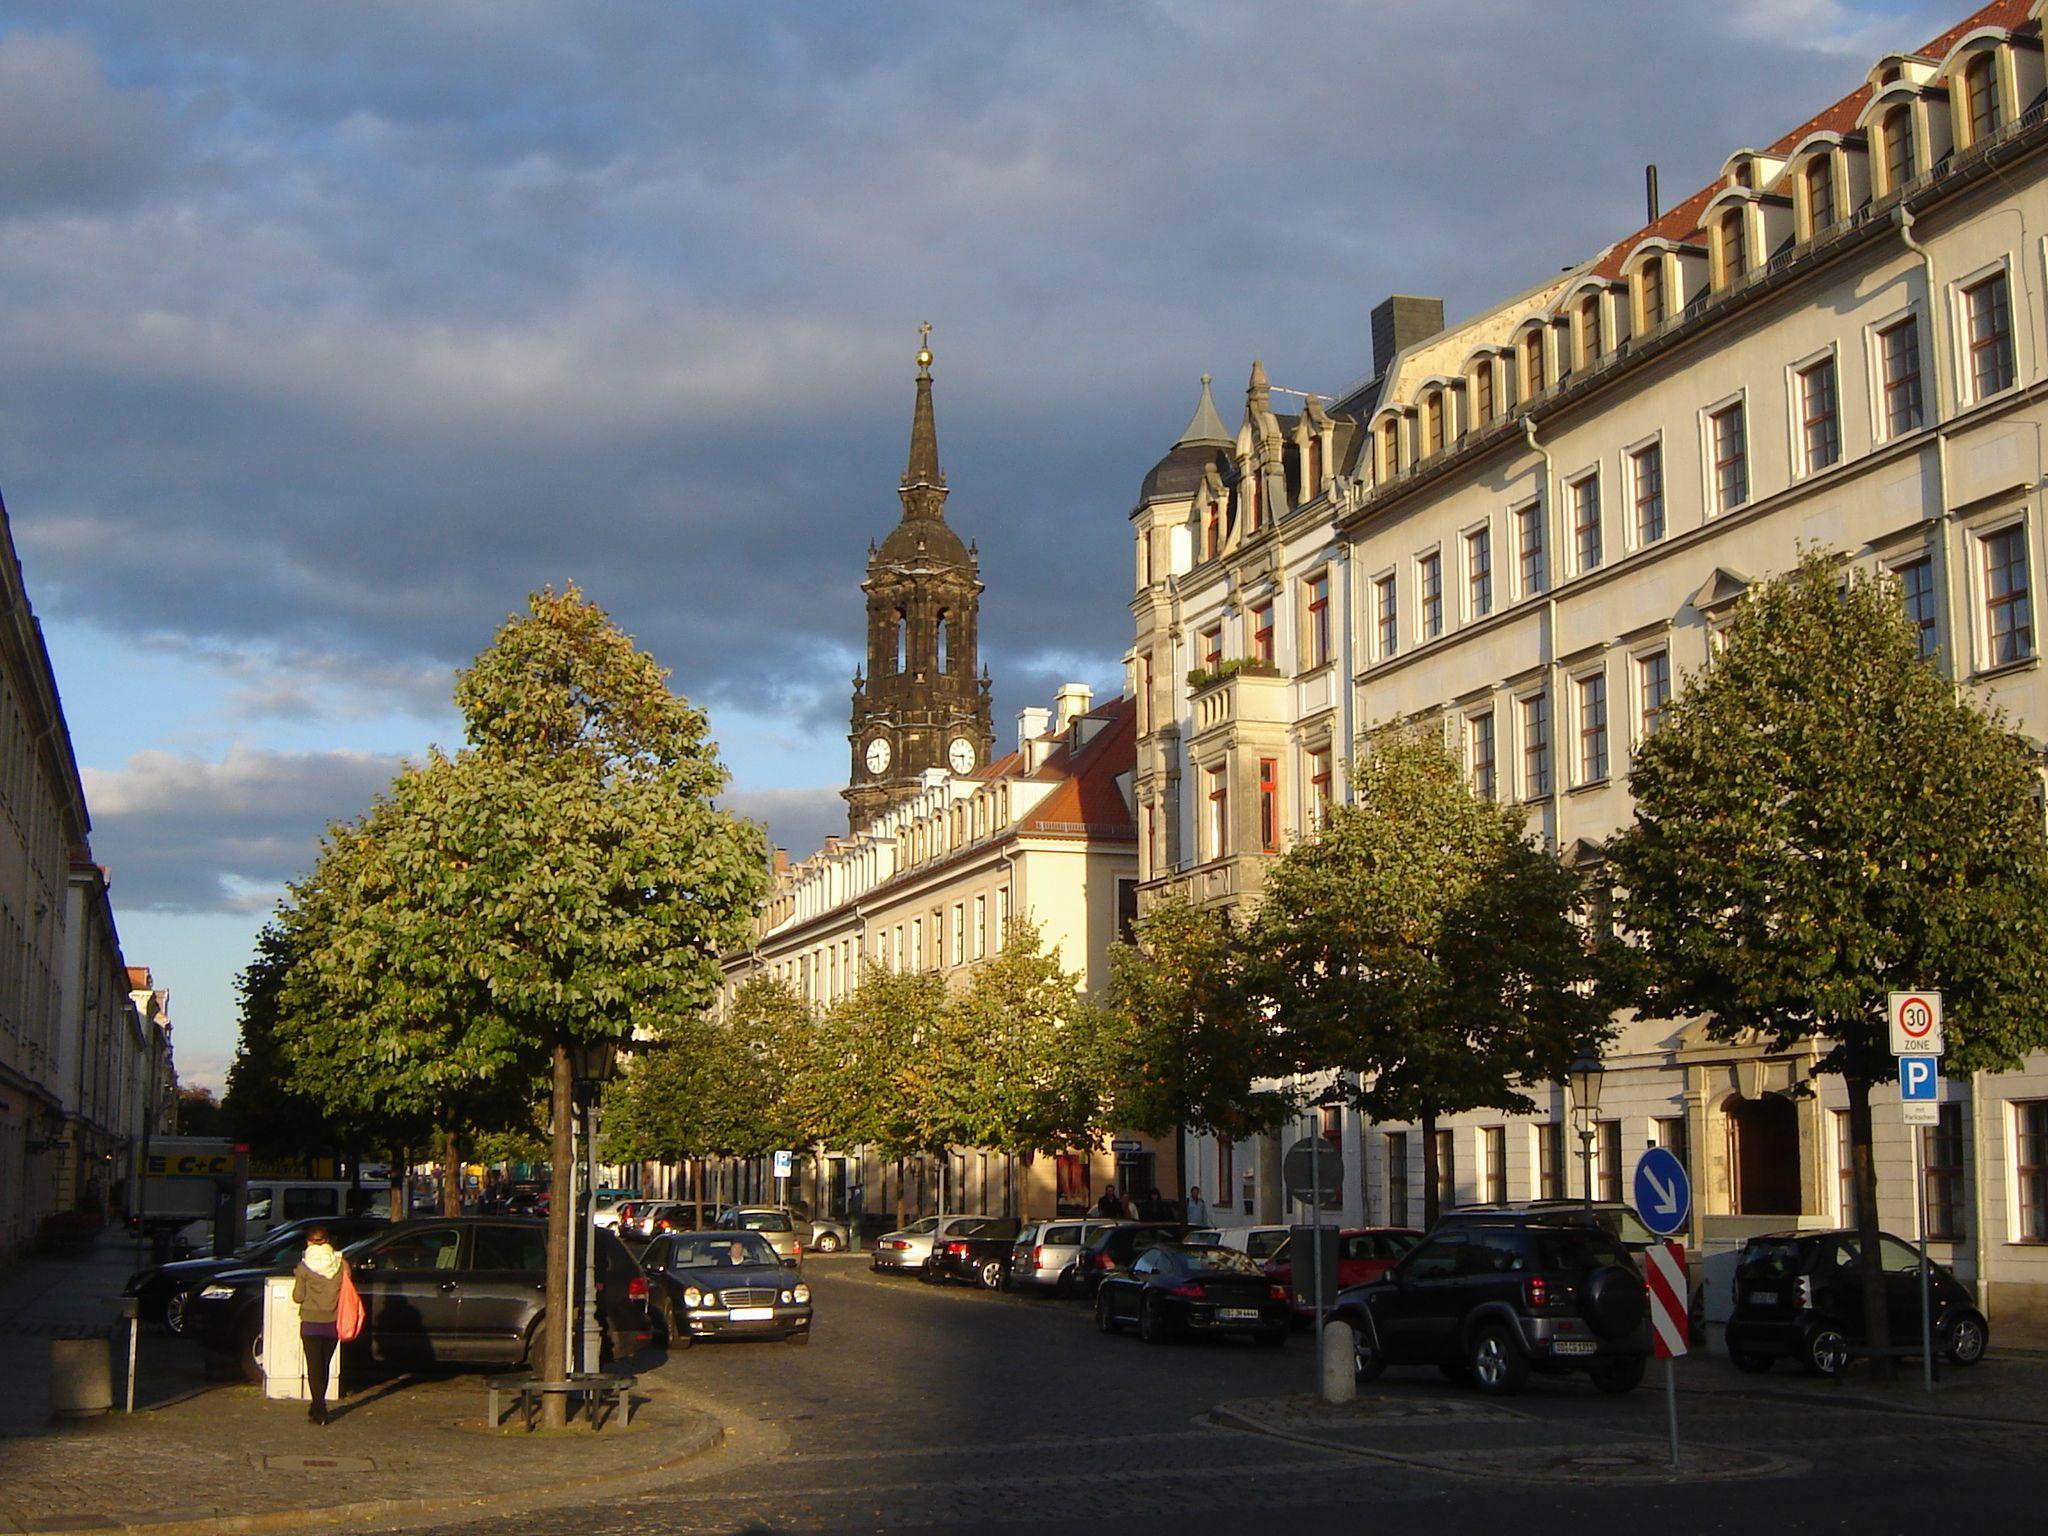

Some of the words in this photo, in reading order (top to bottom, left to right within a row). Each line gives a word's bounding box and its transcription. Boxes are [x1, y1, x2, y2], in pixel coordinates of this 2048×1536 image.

[1906, 1008, 1926, 1026] 30
[1904, 1039, 1931, 1051] ZONE
[1908, 1062, 1928, 1095] P
